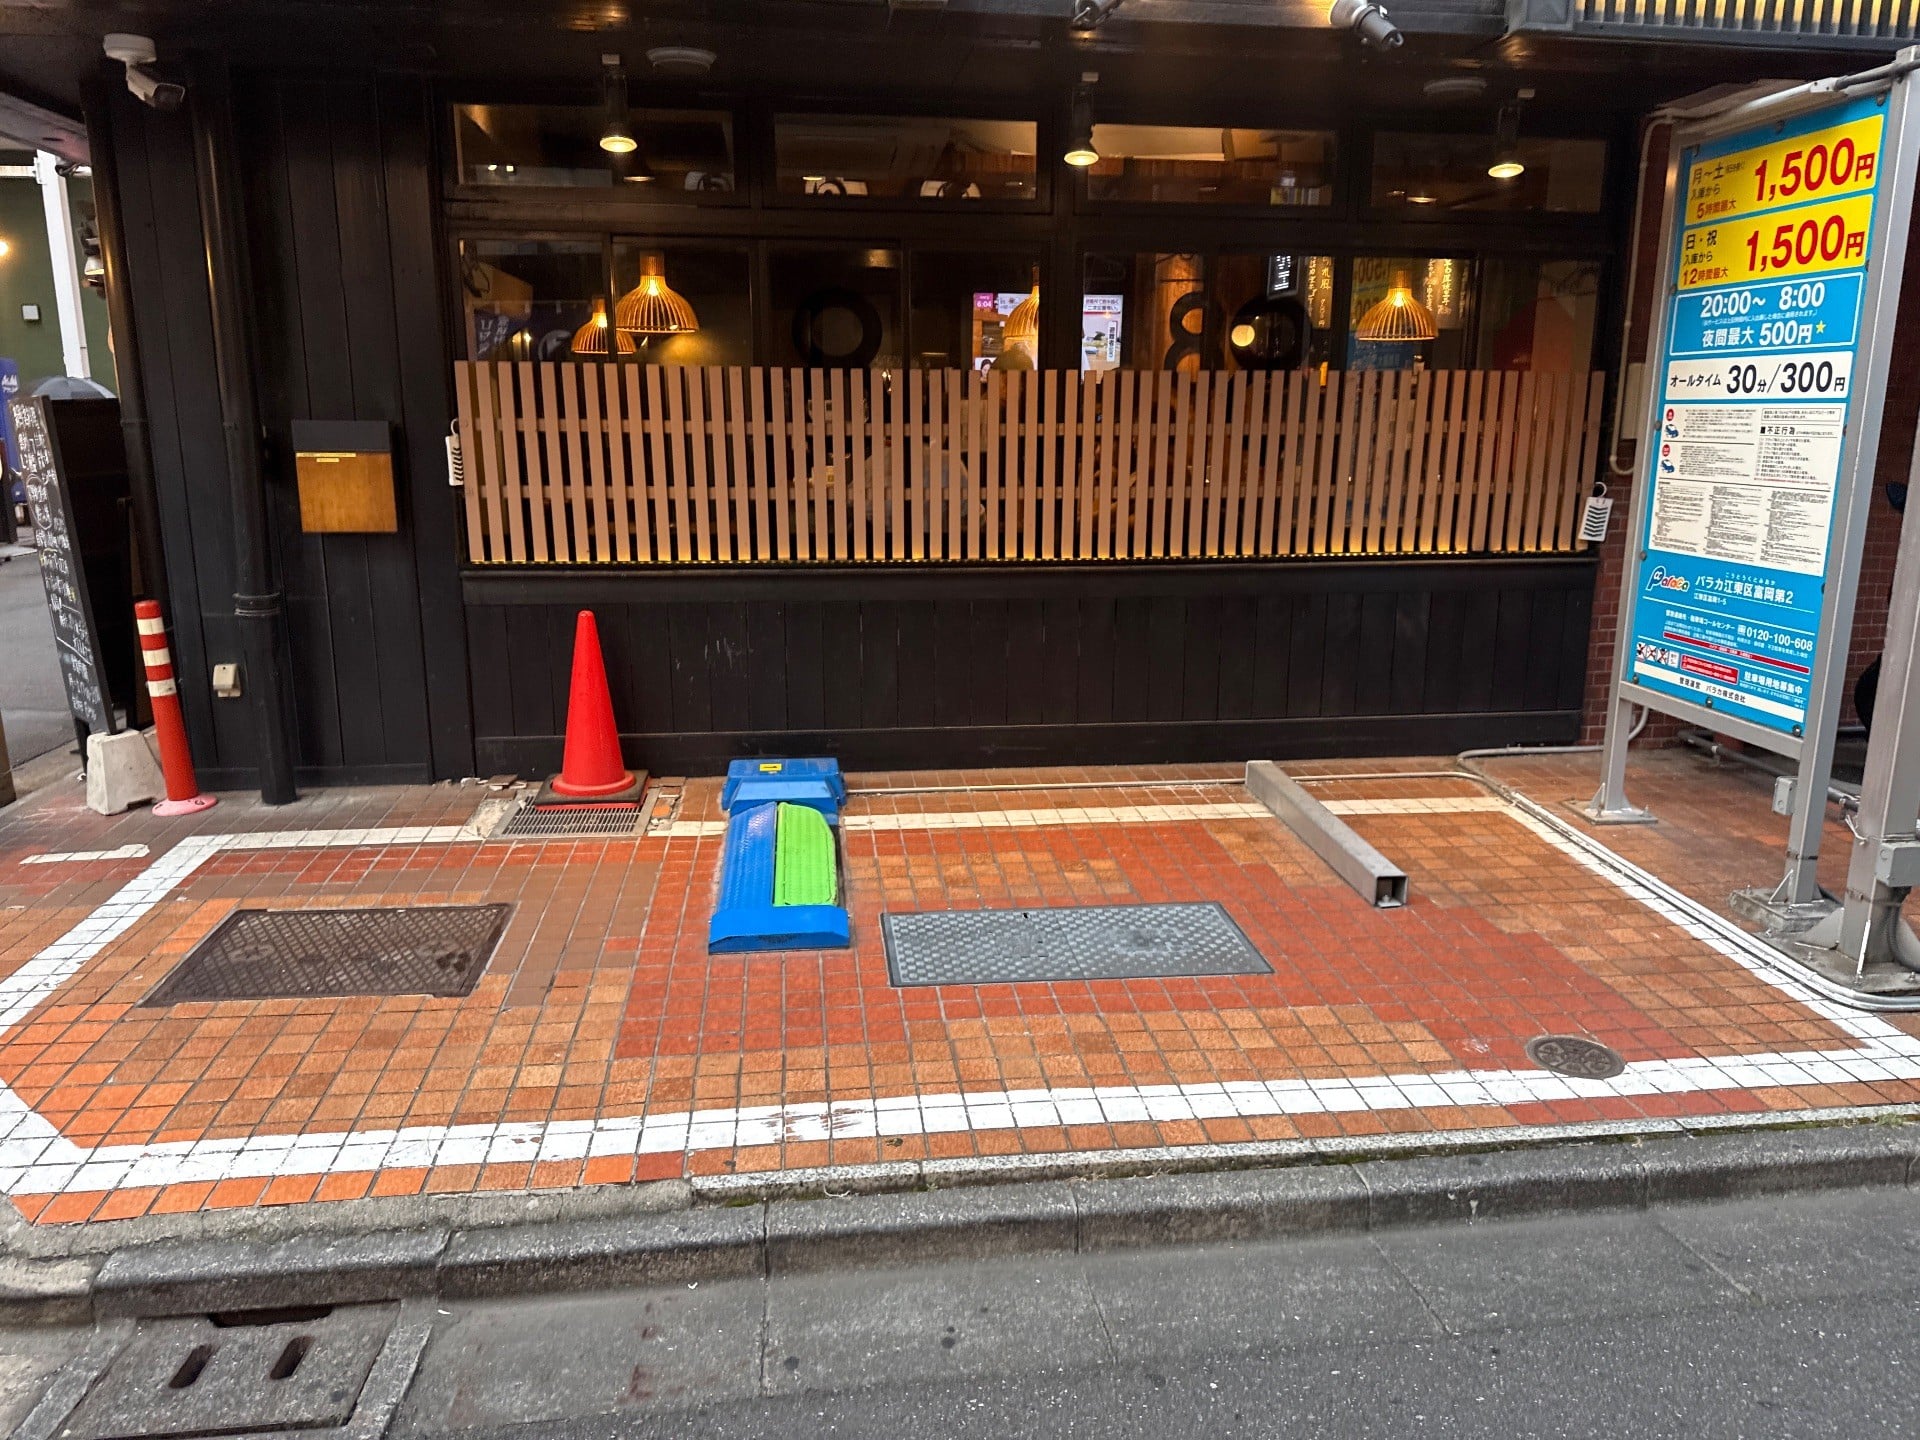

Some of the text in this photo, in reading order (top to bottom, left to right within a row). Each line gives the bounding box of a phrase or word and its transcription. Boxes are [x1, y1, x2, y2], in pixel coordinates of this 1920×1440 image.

[1754, 137, 1876, 202] 1,500円
[1686, 229, 1718, 251] 日・祝
[1746, 214, 1866, 273] 1,500円
[1683, 251, 1713, 266] 入庫から
[1683, 267, 1728, 286] 12時間最大
[1778, 282, 1826, 311] 8:00
[1702, 320, 1813, 348] 夜間最大 500円
[1669, 374, 1722, 388] オールタイム
[1767, 426, 1796, 436] 不正行為
[1746, 629, 1814, 652] 0120-100-608
[1706, 685, 1747, 703] パラカ株式会社
[1744, 671, 1803, 695] 駐車場用地募集中
